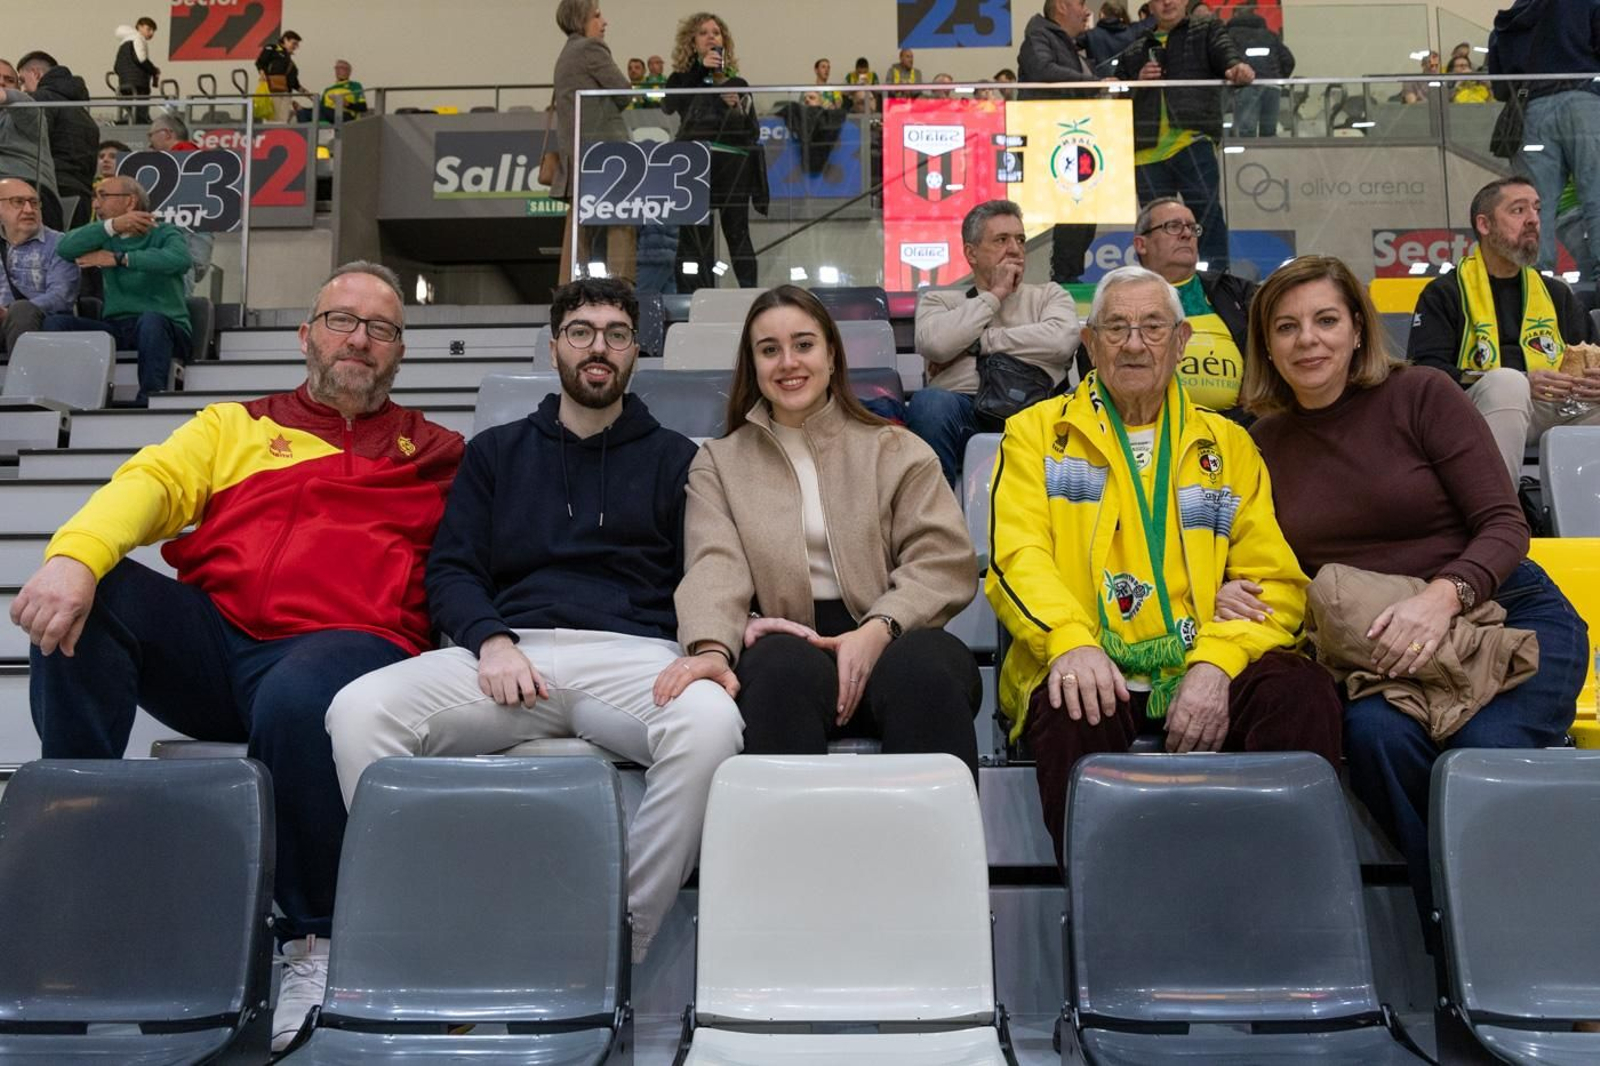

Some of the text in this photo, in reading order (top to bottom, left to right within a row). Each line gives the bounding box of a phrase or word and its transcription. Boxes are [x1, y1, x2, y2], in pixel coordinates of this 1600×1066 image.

[168, 0, 281, 61] 22
[898, 0, 1011, 47] 23
[116, 150, 242, 231] 23
[581, 141, 711, 225] 23
[1300, 177, 1425, 197] olivo arena
[579, 195, 676, 220] Sector
[1373, 231, 1478, 268] Sect
[1181, 350, 1237, 377] aén
